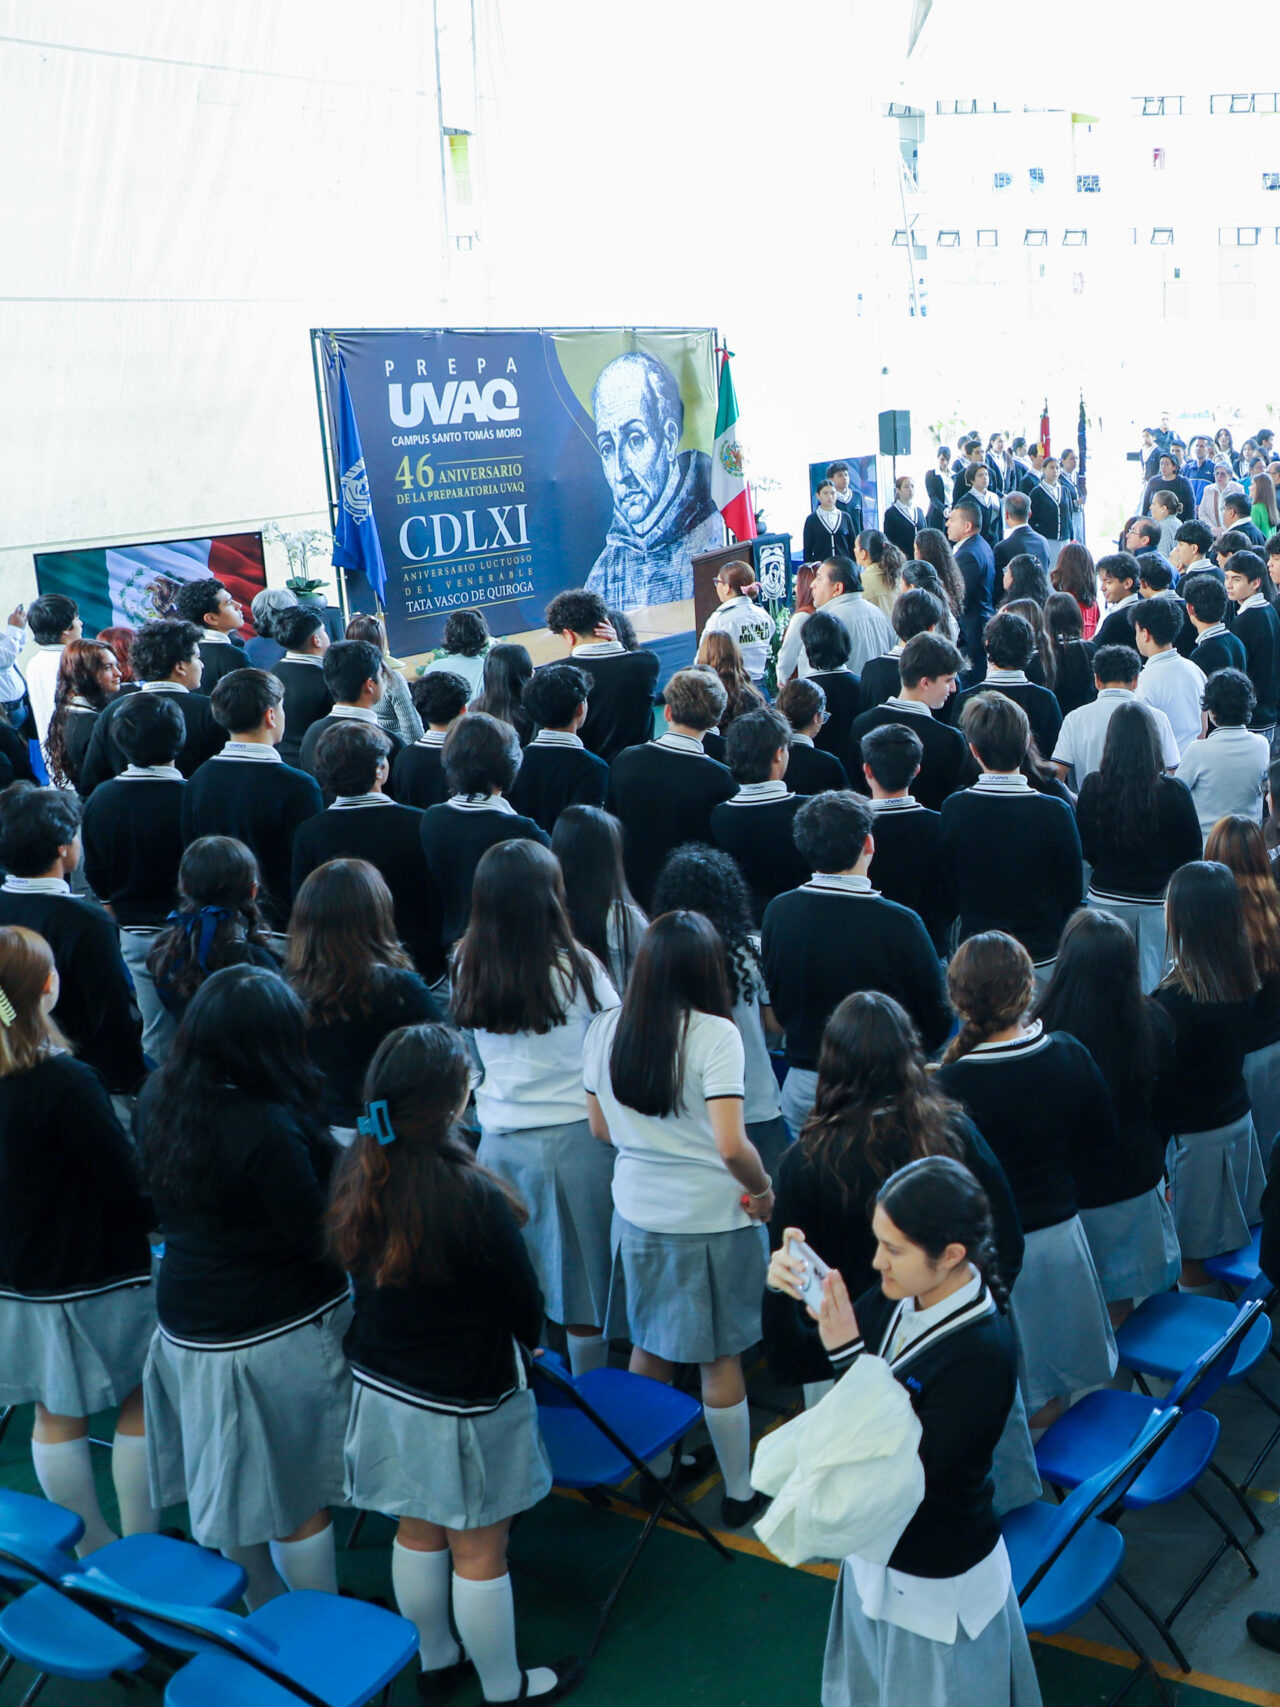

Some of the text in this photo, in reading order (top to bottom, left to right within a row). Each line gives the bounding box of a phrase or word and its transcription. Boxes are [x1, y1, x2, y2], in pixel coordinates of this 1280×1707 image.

[385, 357, 518, 377] PREPA
[388, 378, 520, 429] UVAQ
[391, 427, 522, 447] CAMPUS SANTO TOMÁS MORO
[395, 453, 522, 490] 46 ANIVERSARIO
[396, 481, 525, 505] DE LA PREPARATORIA UVAQ
[399, 503, 531, 561] CDLXI
[403, 554, 532, 583] ANIVERSARIO LUCTUOSO
[404, 567, 533, 597] DEL VENERABLE
[406, 581, 535, 613] TATA VASCO DE QUIROGA
